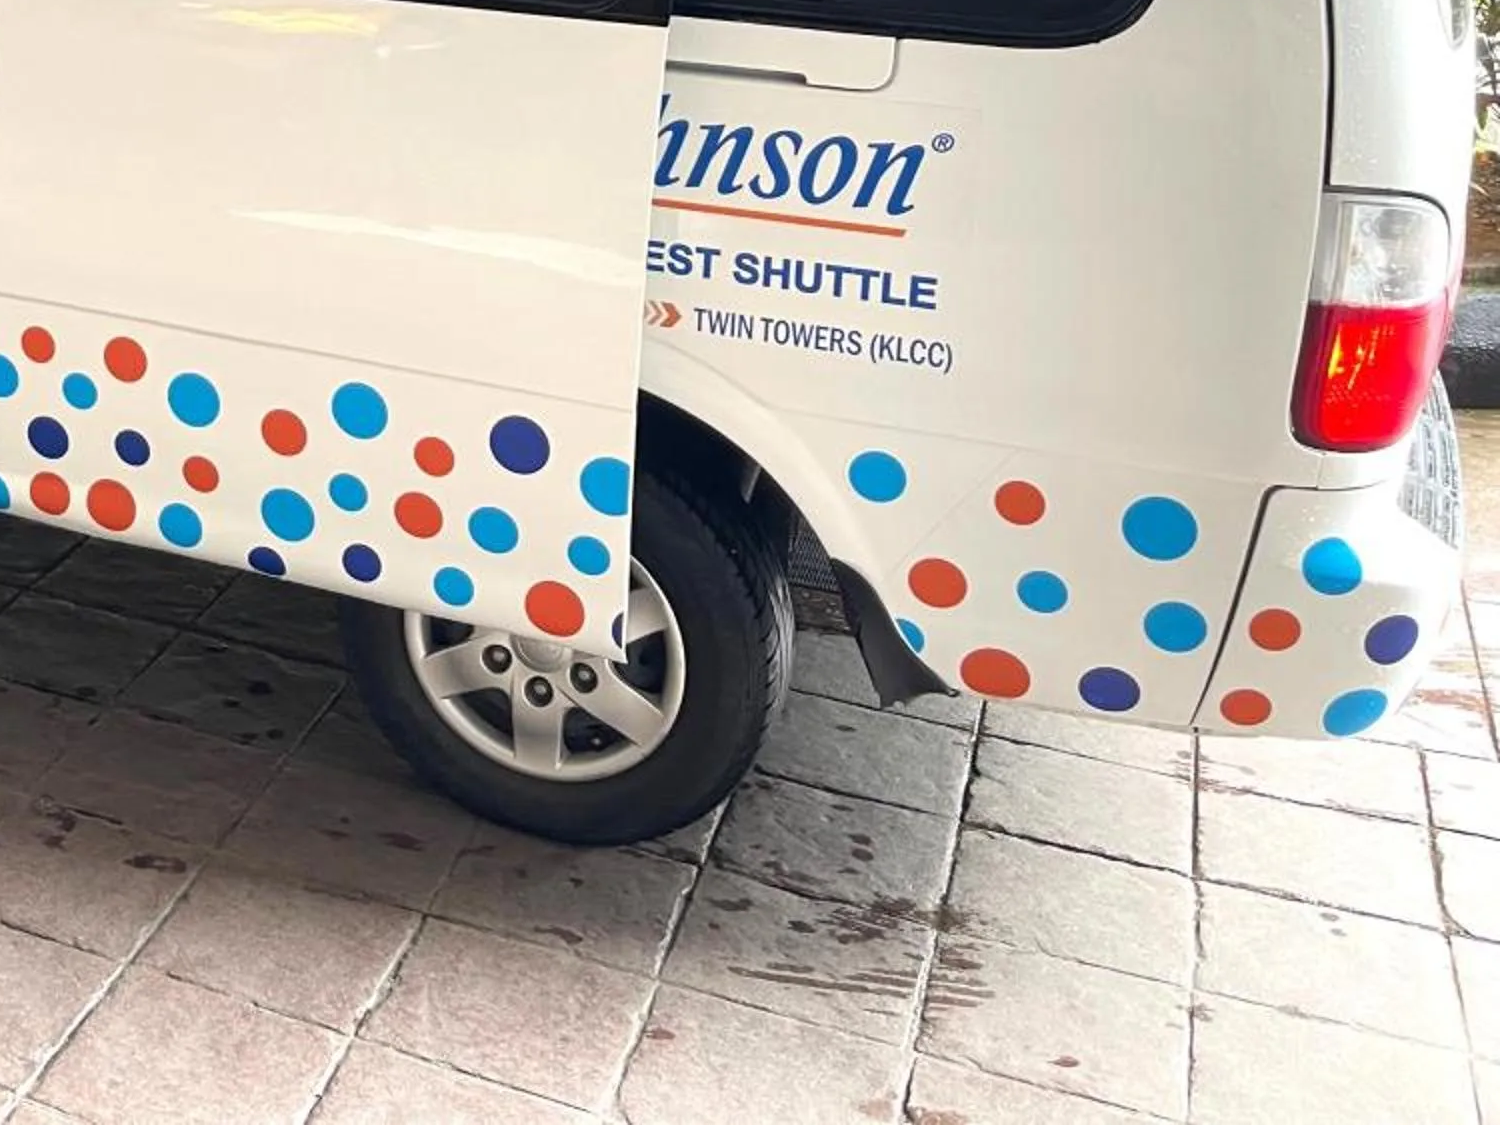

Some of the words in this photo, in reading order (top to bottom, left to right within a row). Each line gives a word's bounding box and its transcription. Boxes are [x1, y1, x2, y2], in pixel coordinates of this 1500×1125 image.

[645, 240, 721, 278] EST
[733, 252, 939, 310] SHUTTLE
[694, 307, 754, 341] TWIN
[760, 318, 862, 356] TOWERS
[870, 334, 953, 374] (KLCC)
